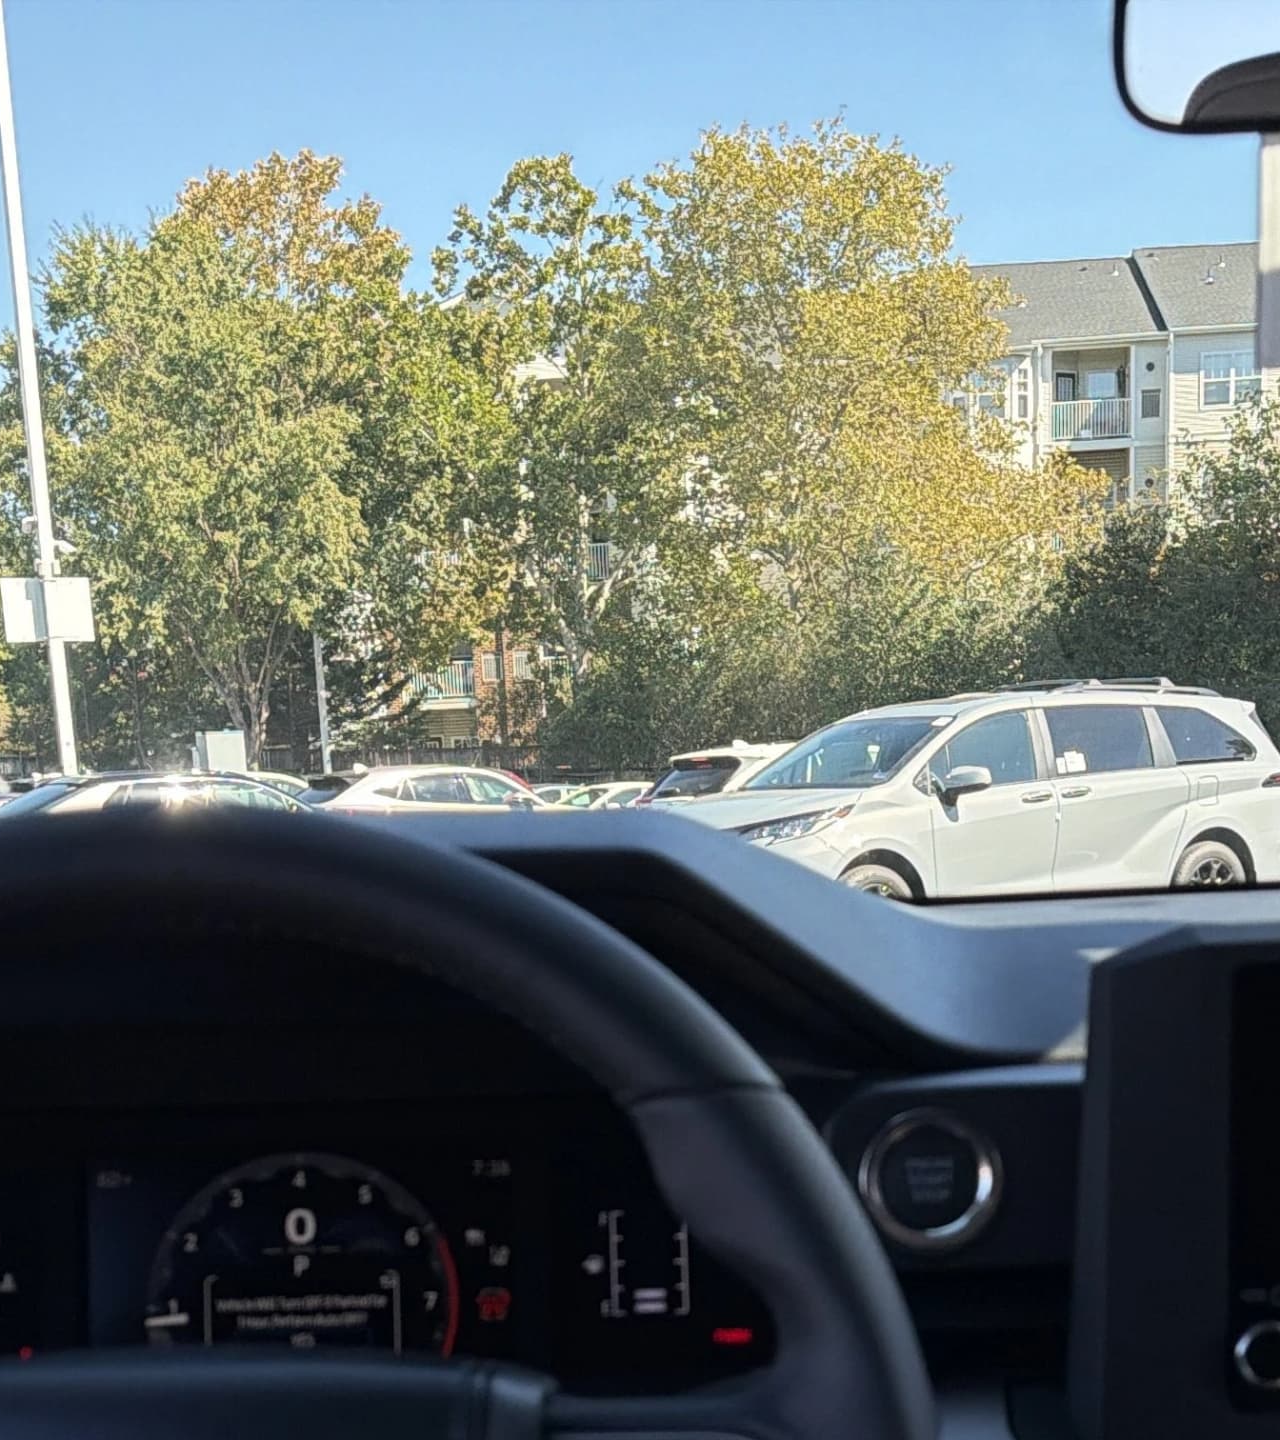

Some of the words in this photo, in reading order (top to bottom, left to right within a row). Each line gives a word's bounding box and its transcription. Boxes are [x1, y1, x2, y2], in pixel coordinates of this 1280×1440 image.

[290, 1170, 307, 1190] 4
[228, 1188, 244, 1208] 3
[358, 1184, 373, 1205] 5
[284, 1207, 318, 1245] 0
[183, 1232, 199, 1253] 2
[404, 1227, 420, 1247] 6
[292, 1255, 311, 1277] P
[422, 1290, 439, 1312] 7
